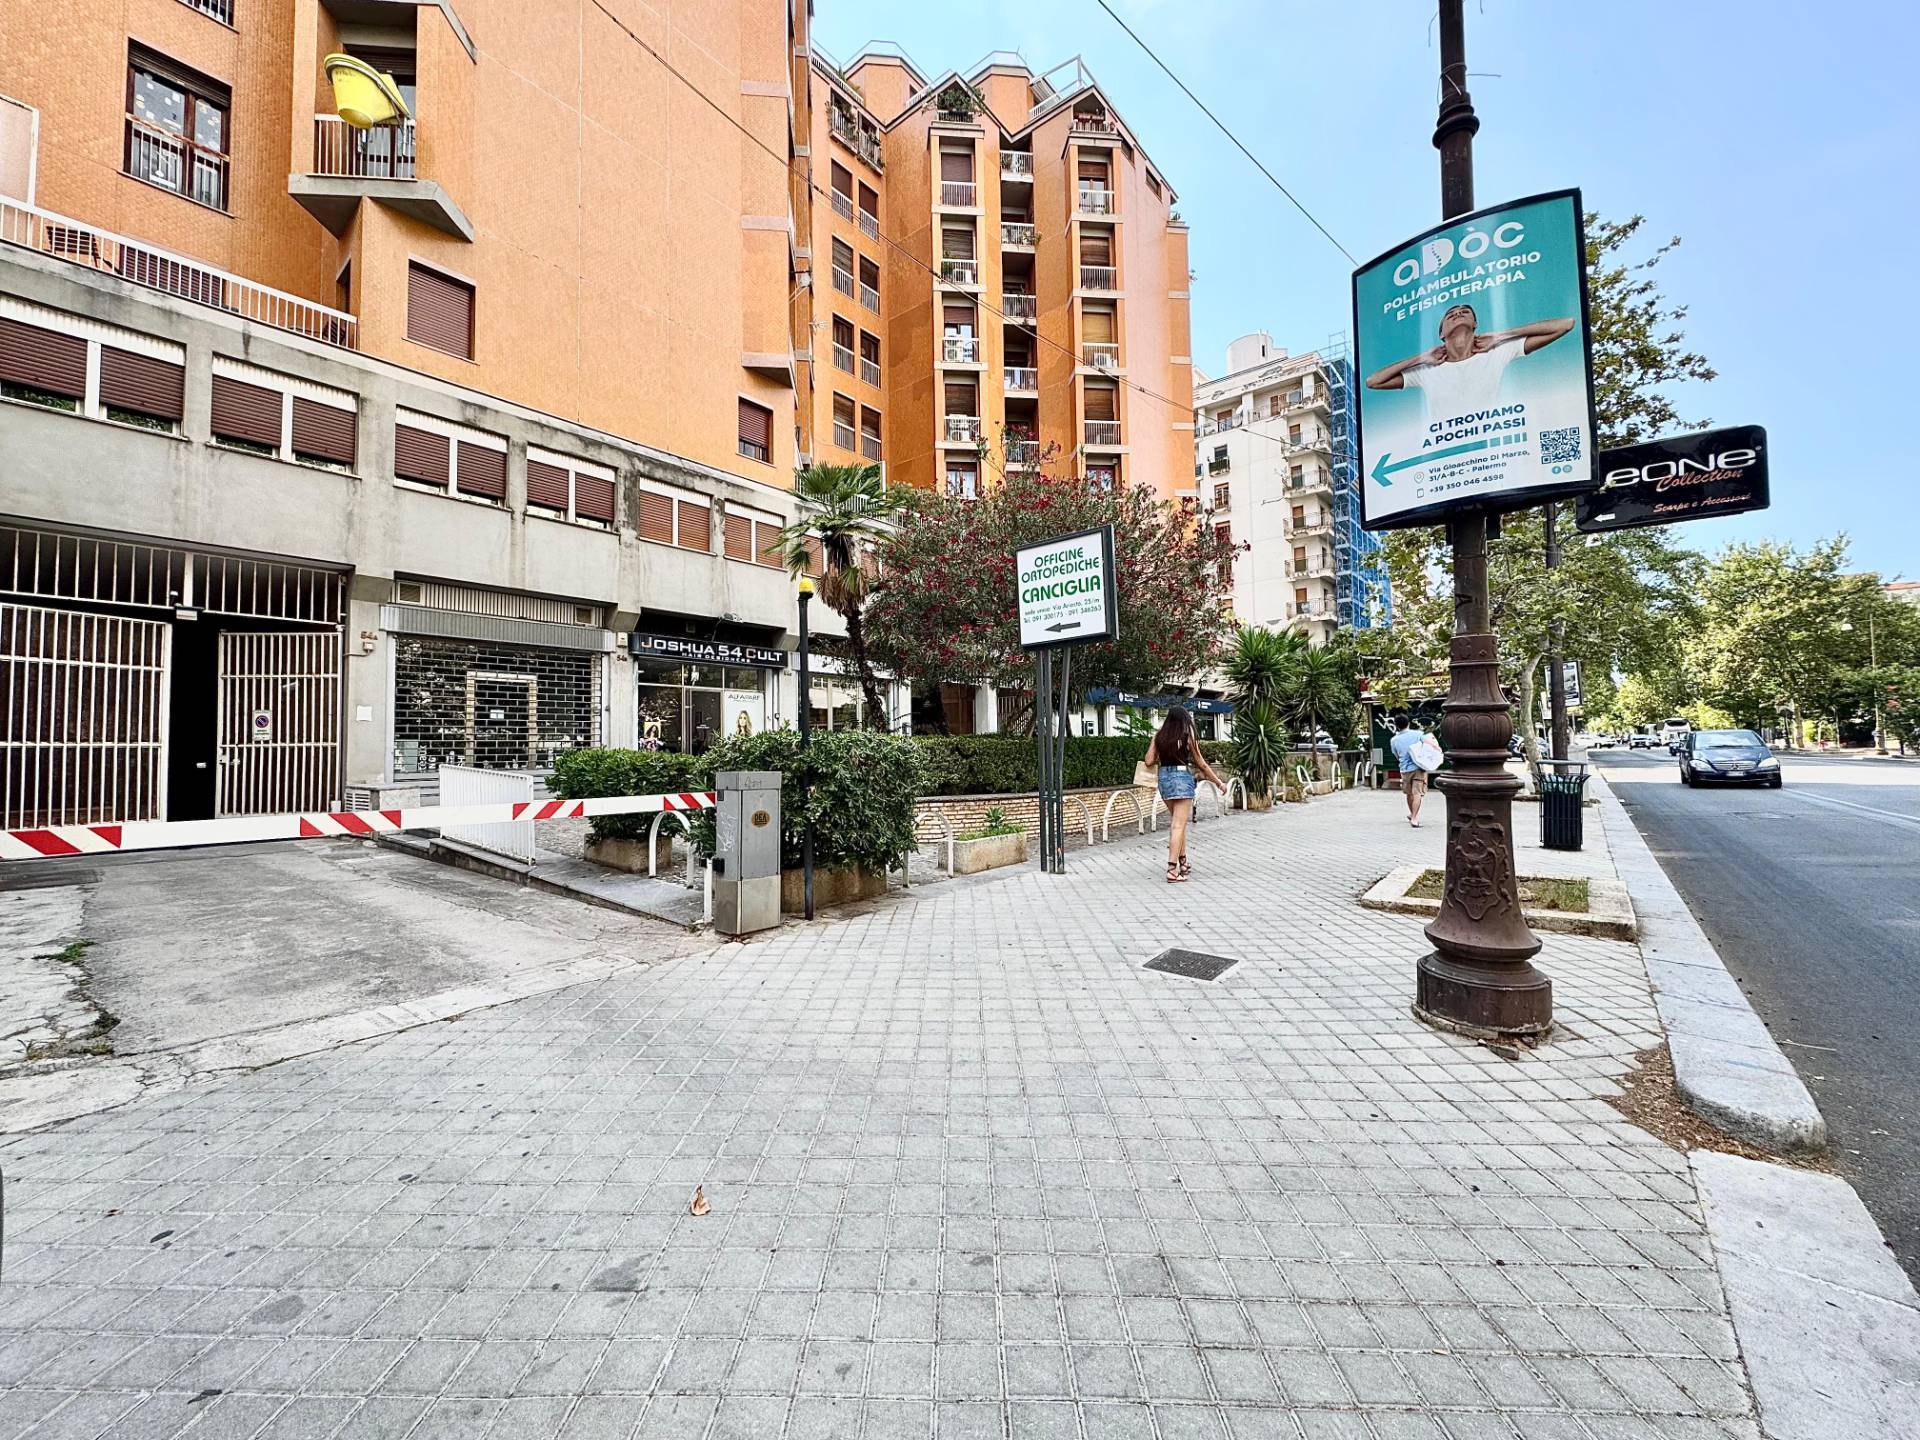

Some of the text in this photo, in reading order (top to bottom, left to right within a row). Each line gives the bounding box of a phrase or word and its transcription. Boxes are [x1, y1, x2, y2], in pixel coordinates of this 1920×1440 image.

[1383, 251, 1541, 314] POLIAMBULATORIO
[1396, 270, 1526, 321] E FISIOTERAPIA
[1429, 404, 1525, 433] CI TROVIAMO
[1422, 417, 1526, 448] A POCHI PASSI
[1429, 470, 1464, 482] 31/A-B-C
[1472, 462, 1507, 472] Palermo
[1443, 456, 1488, 470] Gioacchino
[1446, 481, 1461, 489] 350
[1463, 478, 1480, 486] 046
[1482, 474, 1504, 482] 4598
[1656, 468, 1743, 492] Collection
[1653, 503, 1689, 513] Scarpe
[1021, 557, 1100, 583] ORTOPEDICHE
[1034, 547, 1083, 568] OFFICINE
[1022, 575, 1101, 603] CANCIGLIA
[641, 637, 783, 662] JOSHUA 54 CULT
